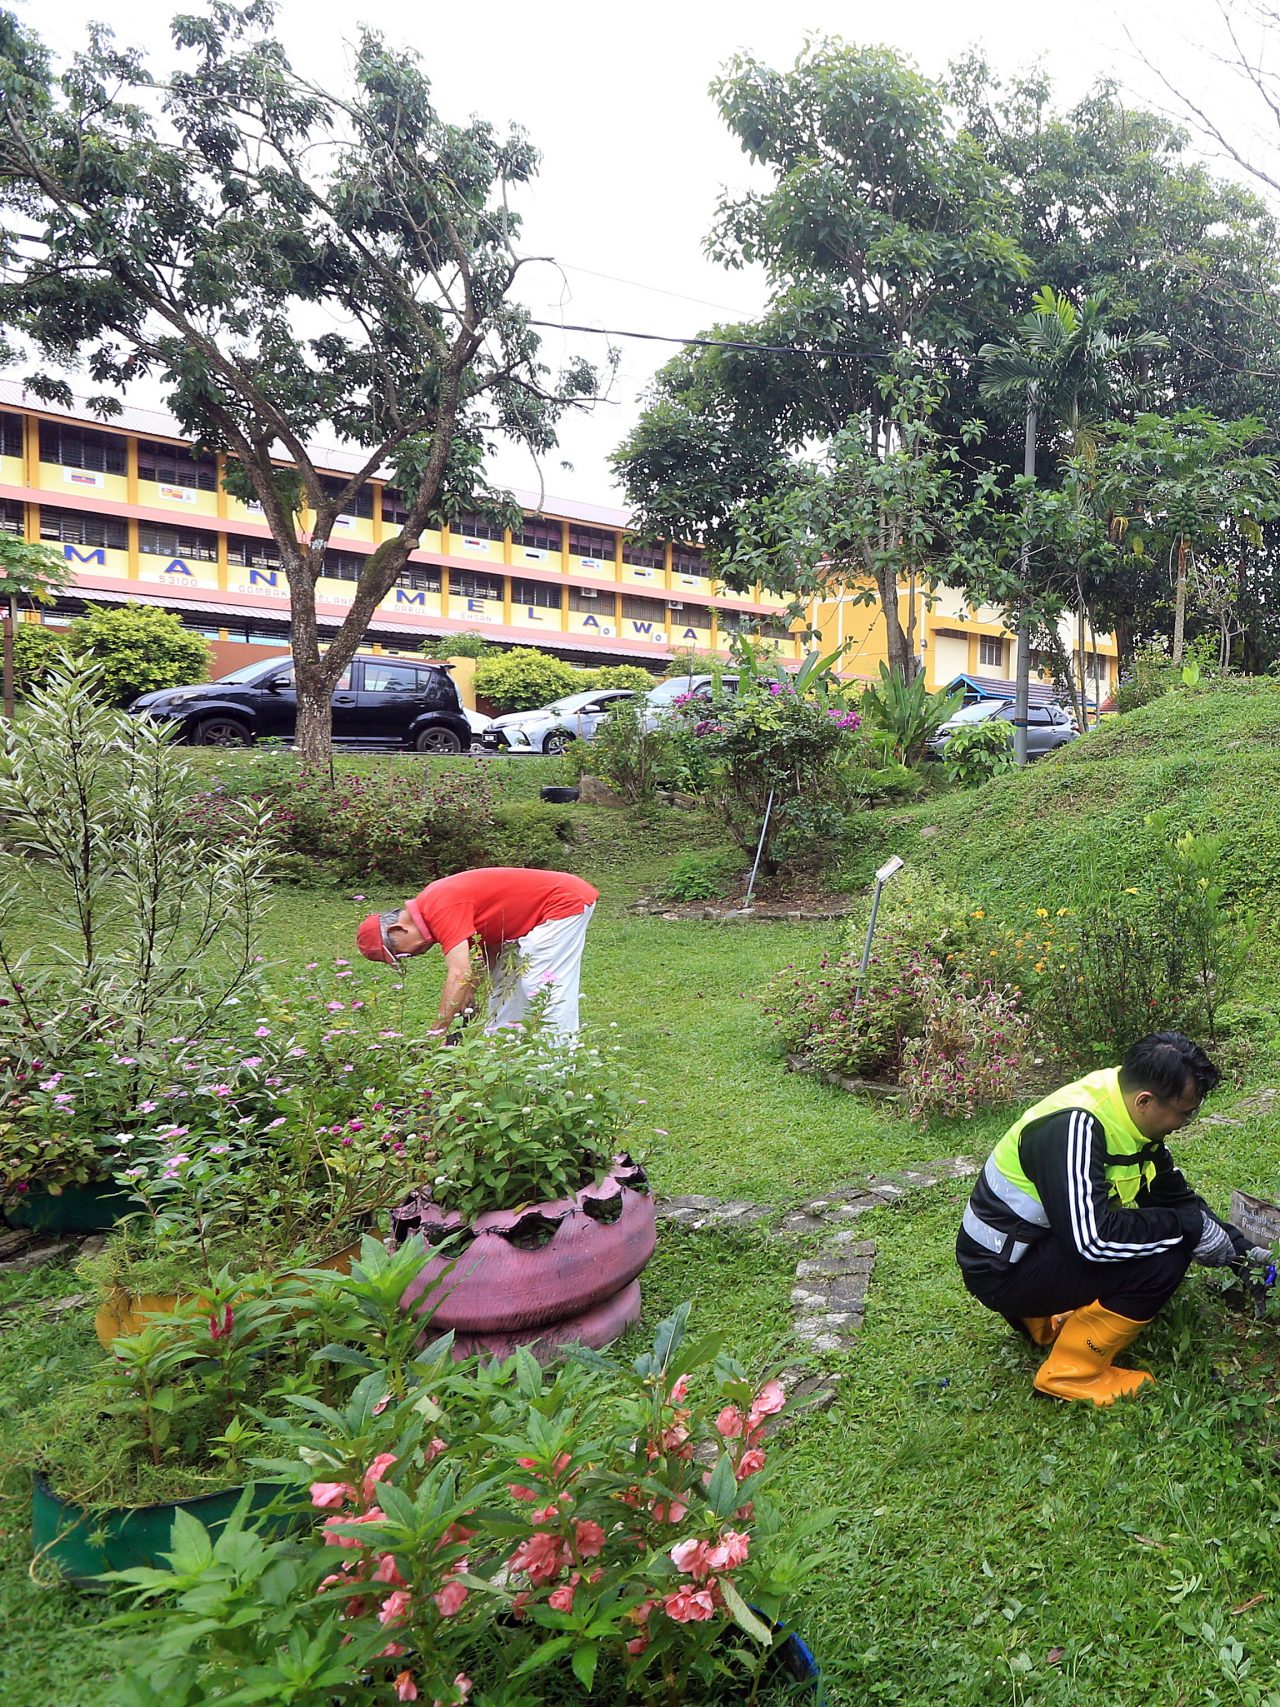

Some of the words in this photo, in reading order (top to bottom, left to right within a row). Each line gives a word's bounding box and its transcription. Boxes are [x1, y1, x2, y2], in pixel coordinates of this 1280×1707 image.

[158, 575, 199, 587] 53100
[239, 584, 288, 597] GOMBAK
[394, 604, 427, 616] DARUL
